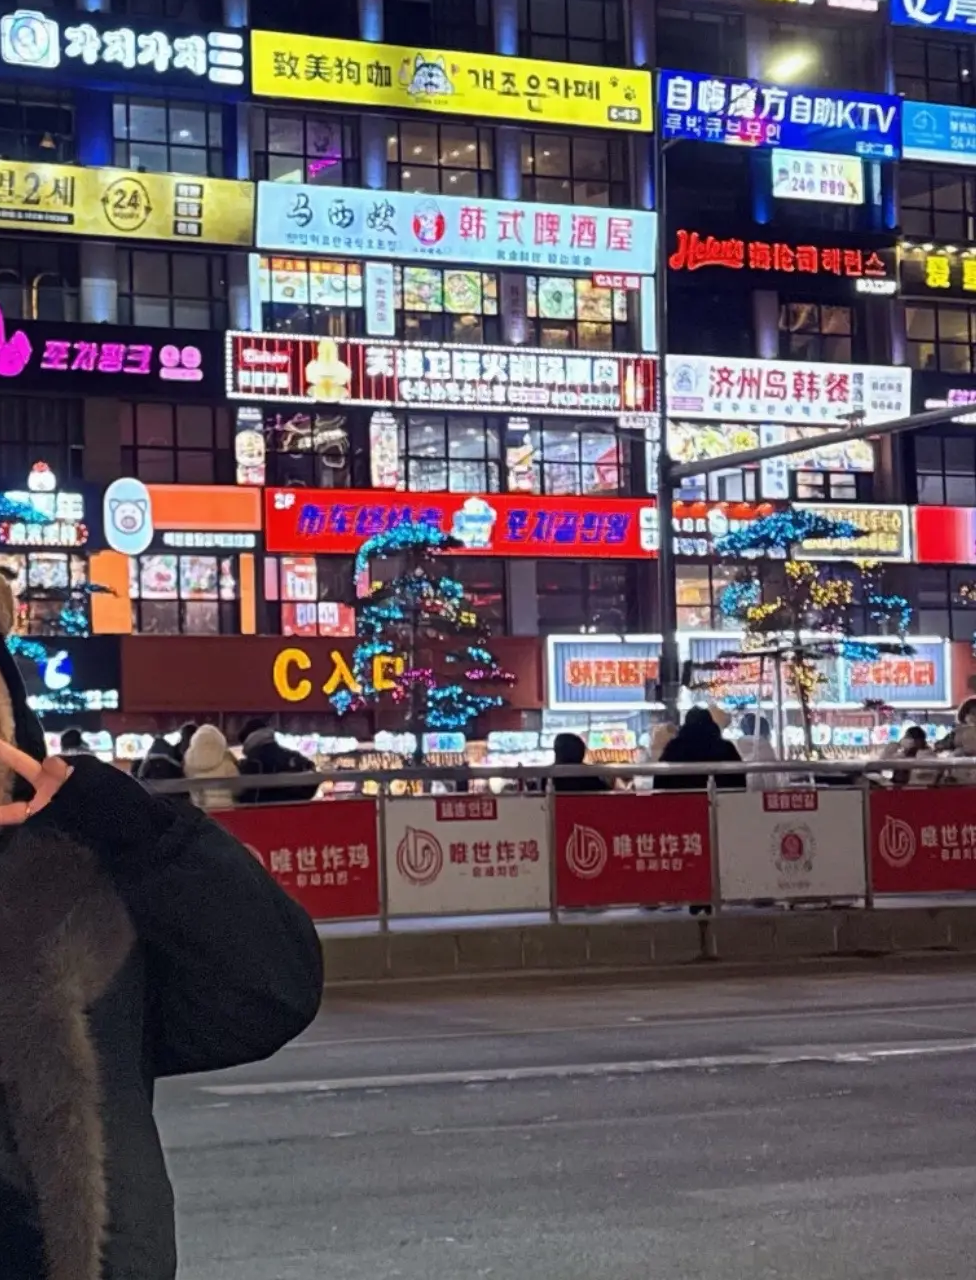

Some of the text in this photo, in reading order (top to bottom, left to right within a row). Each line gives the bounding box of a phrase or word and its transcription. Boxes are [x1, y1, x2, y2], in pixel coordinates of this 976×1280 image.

[113, 188, 140, 210] 24
[459, 206, 634, 252] 韩式啤酒屋
[709, 366, 850, 404] 济州岛韩餐
